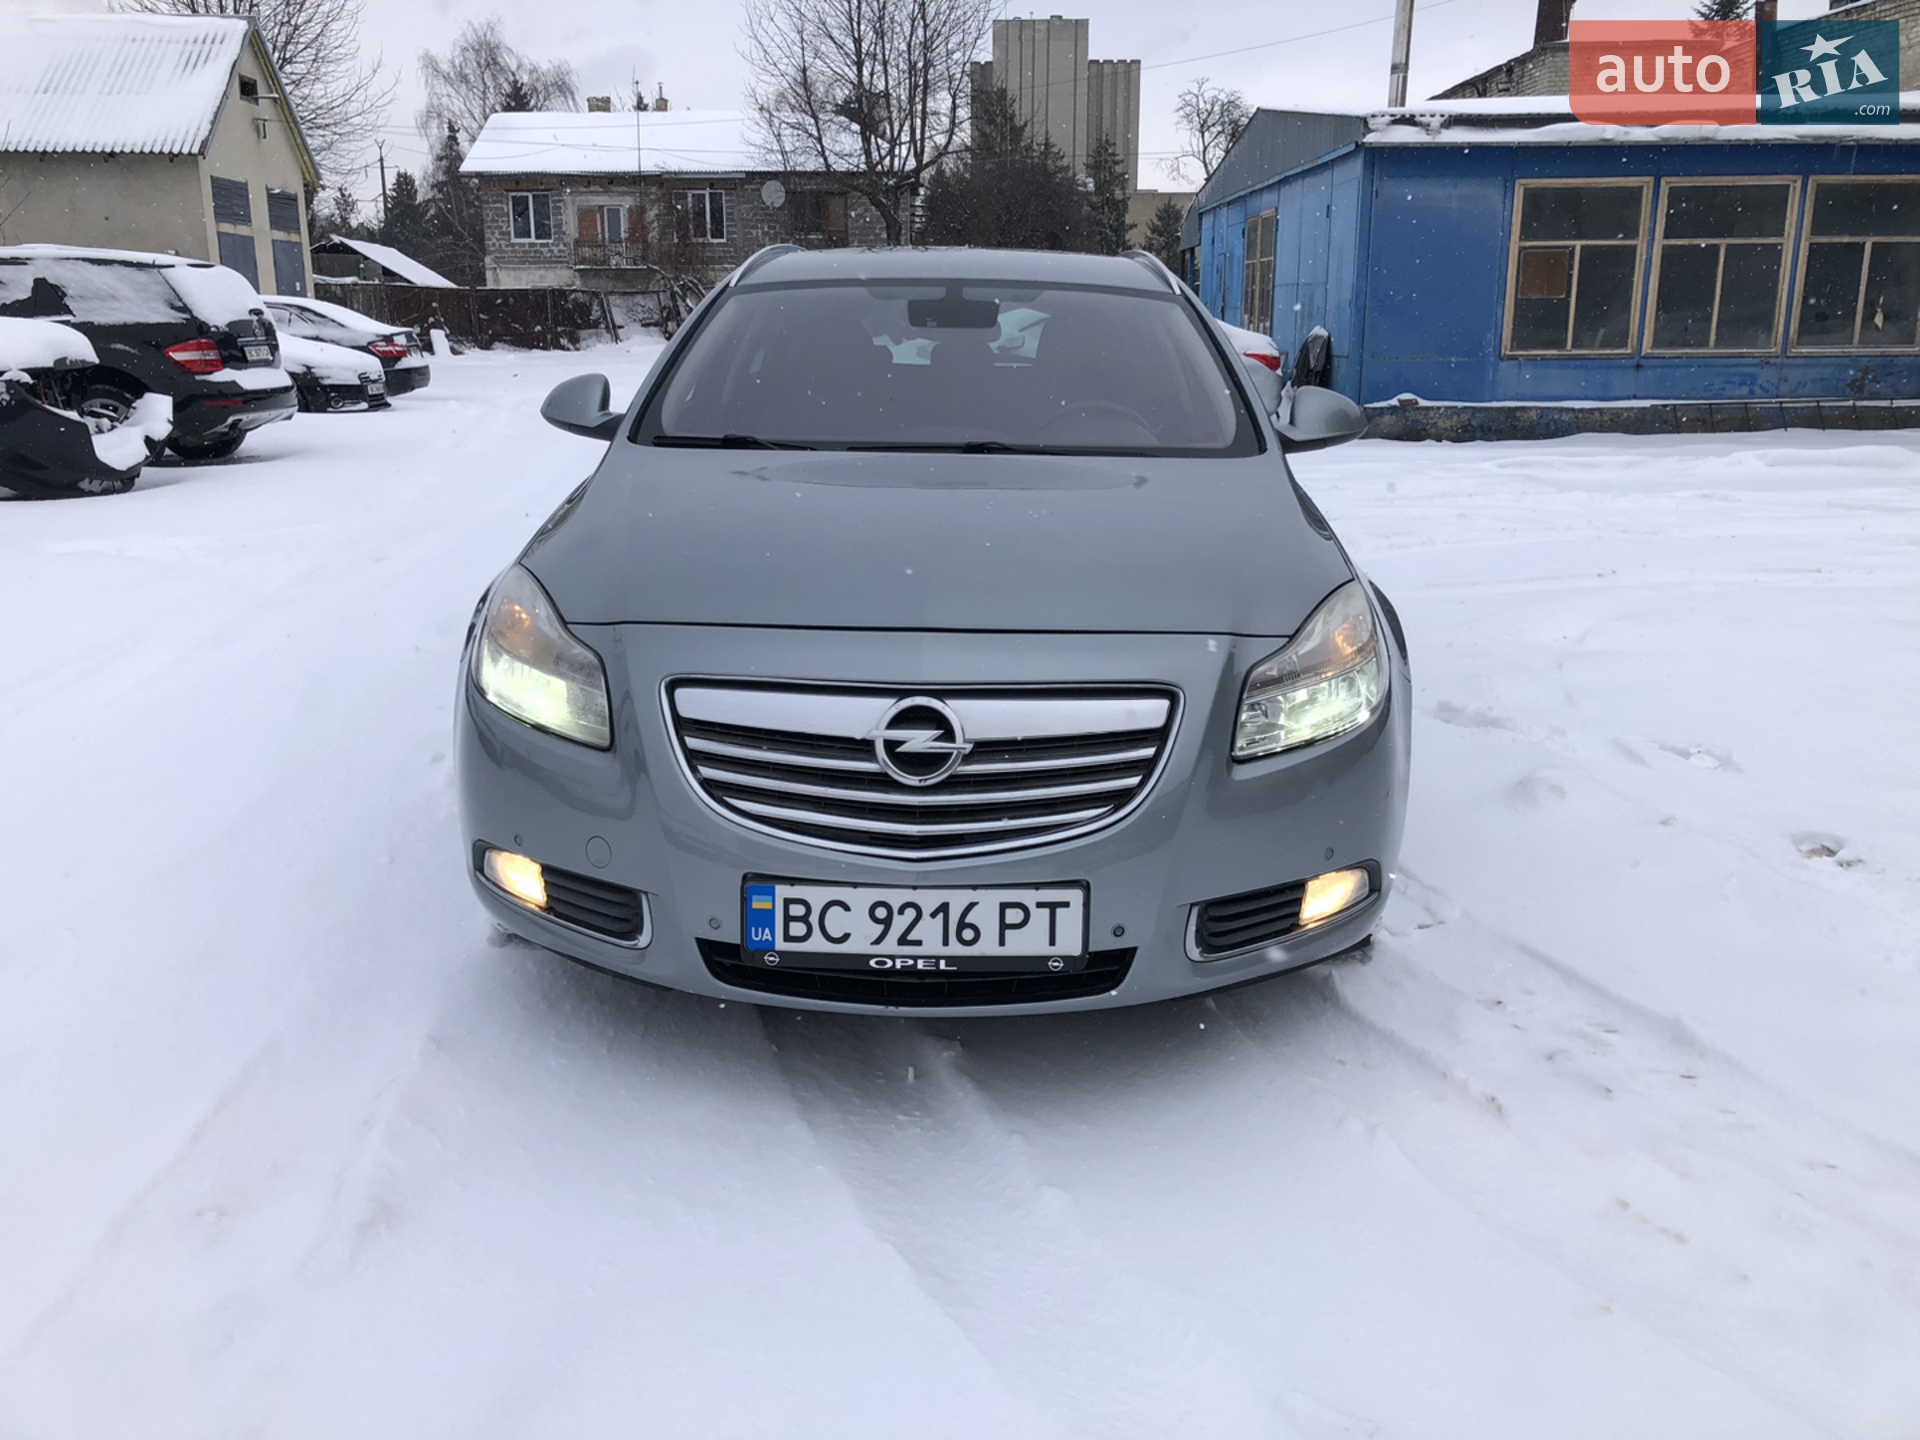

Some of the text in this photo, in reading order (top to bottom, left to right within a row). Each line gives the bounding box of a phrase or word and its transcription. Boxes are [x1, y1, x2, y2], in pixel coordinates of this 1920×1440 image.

[894, 698, 947, 711] OPEL
[782, 897, 1071, 948] BC 9216 PT
[751, 926, 773, 942] UA
[868, 957, 958, 971] OPEL
